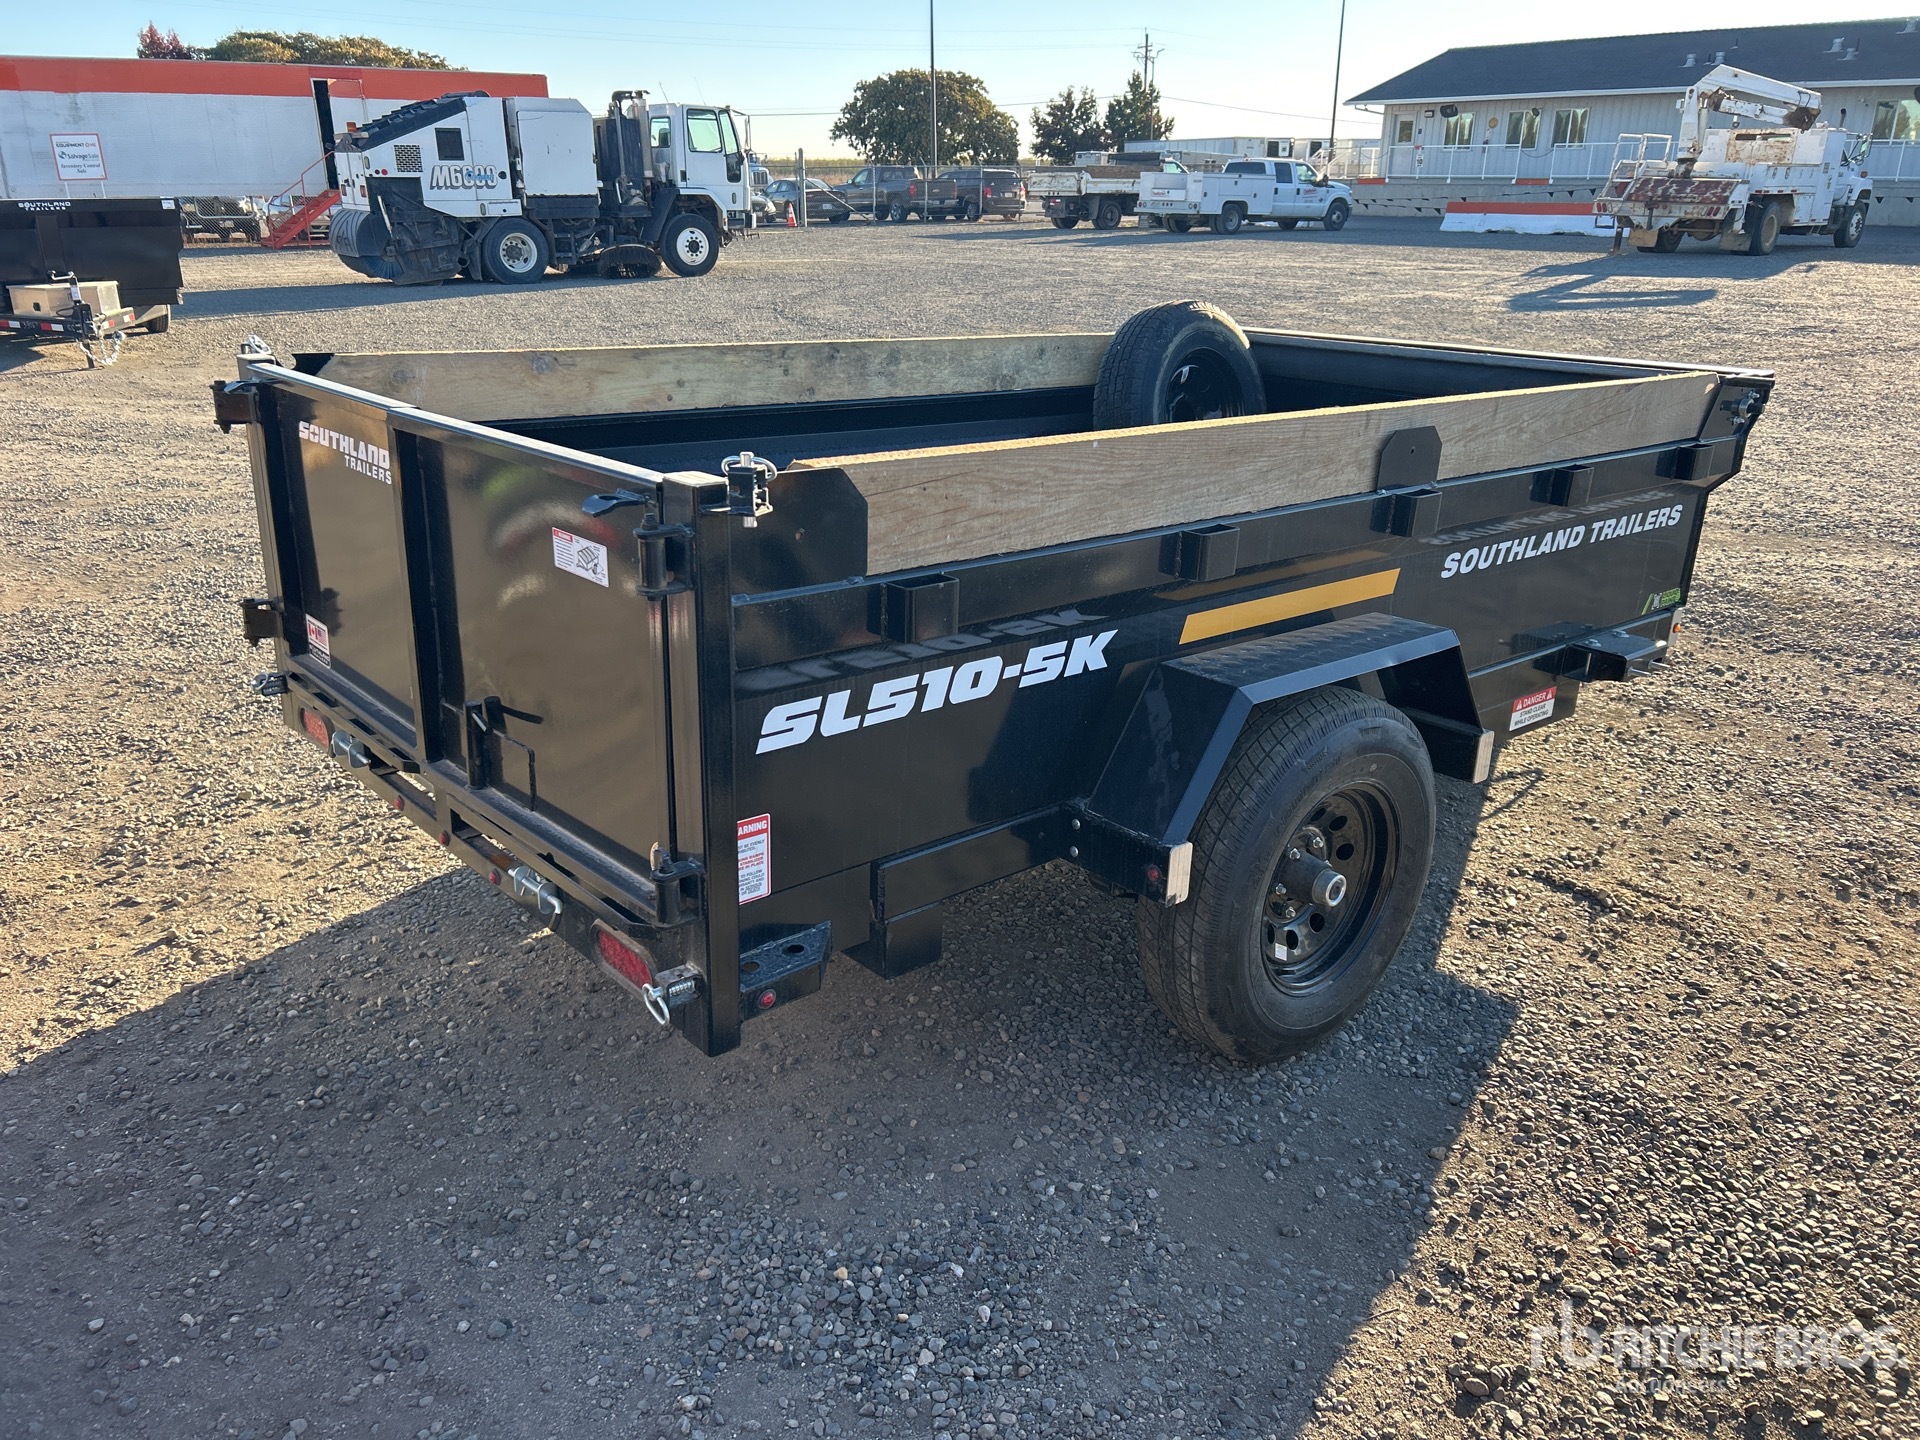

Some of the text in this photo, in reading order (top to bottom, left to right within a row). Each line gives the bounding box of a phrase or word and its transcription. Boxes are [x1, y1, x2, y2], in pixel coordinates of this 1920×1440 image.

[299, 421, 390, 469] SOUTHLAND
[344, 455, 392, 485] TRAILERS
[1440, 504, 1684, 579] SOUTHLAND TRAILERS
[755, 629, 1119, 755] SL510-5K
[1522, 692, 1547, 708] DANGER
[738, 820, 768, 836] ARNING
